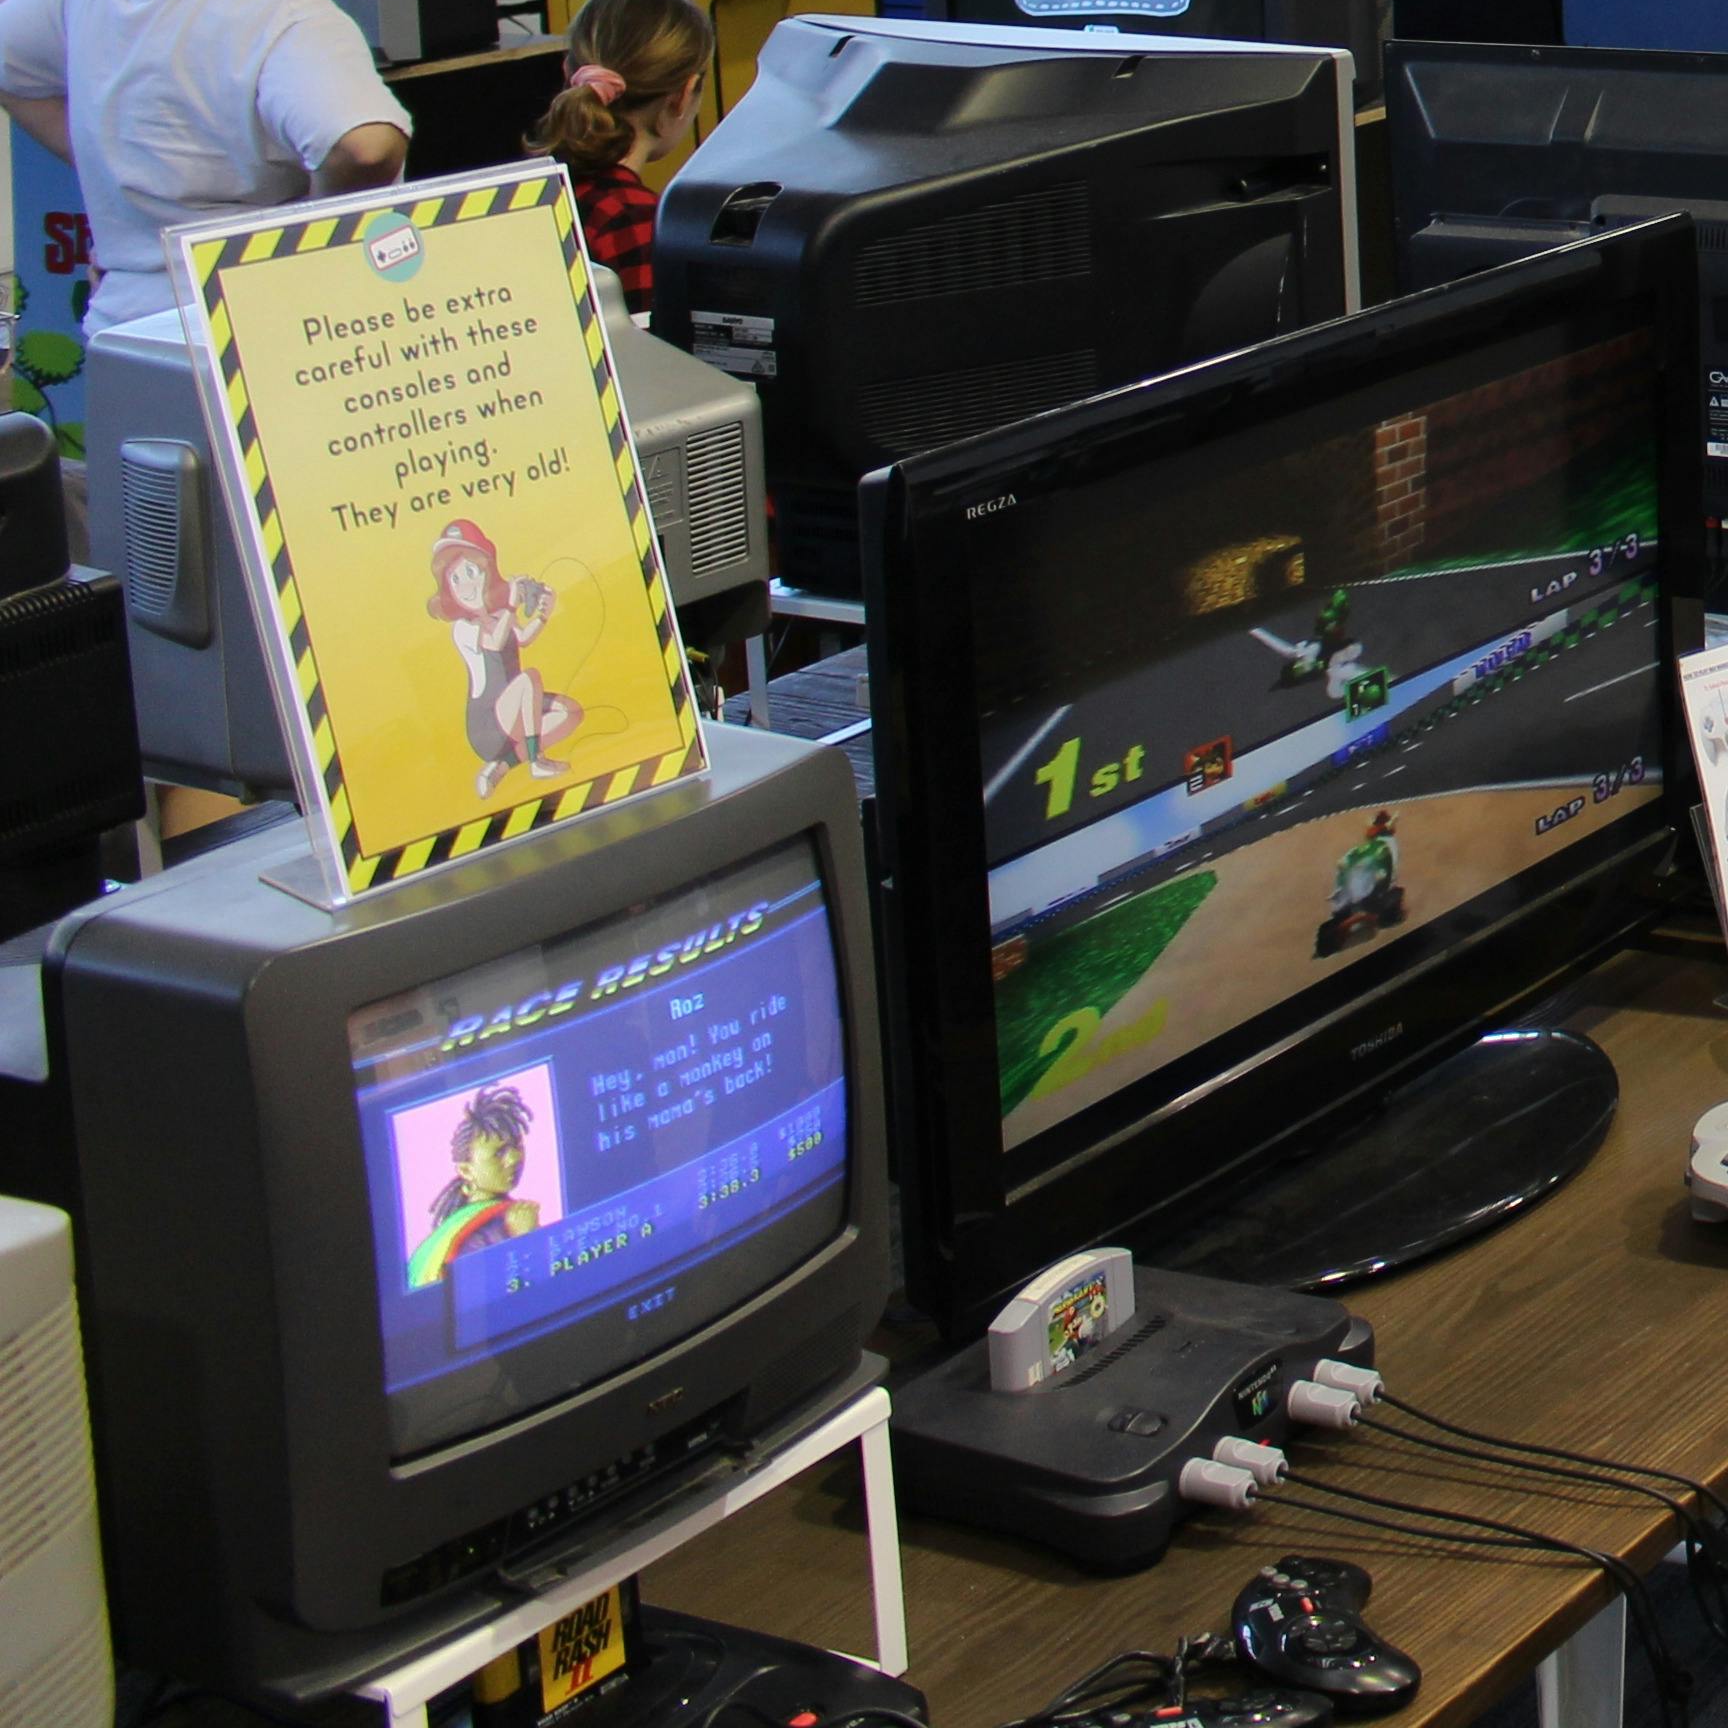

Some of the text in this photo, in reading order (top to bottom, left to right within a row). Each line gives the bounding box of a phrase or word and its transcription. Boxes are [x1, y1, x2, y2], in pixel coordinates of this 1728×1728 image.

[303, 287, 513, 345] Please be extra
[295, 318, 538, 386] careful with these
[344, 350, 511, 413] consoles and
[328, 389, 543, 456] controllers when
[331, 447, 570, 531] They are very old!
[394, 438, 498, 489] playing.
[966, 493, 1017, 520] REGZA
[1530, 572, 1577, 603] LAP
[1035, 736, 1145, 820] 1st
[1536, 796, 1585, 835] LAP
[440, 901, 769, 1052] RACE RESULTS
[669, 993, 705, 1020] Roz
[653, 1034, 698, 1070] man!
[708, 1020, 740, 1044] You
[750, 995, 787, 1025] ride
[1351, 1021, 1403, 1061] TOSHIBA
[598, 1092, 645, 1122] like
[656, 1081, 669, 1097] a
[752, 1032, 772, 1053] on
[598, 1053, 772, 1152] his mama's back!
[506, 1278, 531, 1293] 3.
[550, 1233, 628, 1277] PLAYER
[641, 1222, 654, 1238] A
[787, 1131, 823, 1161] $500
[628, 1286, 676, 1321] EXIT
[552, 1592, 611, 1653] ROAD
[553, 1618, 612, 1682] RASH
